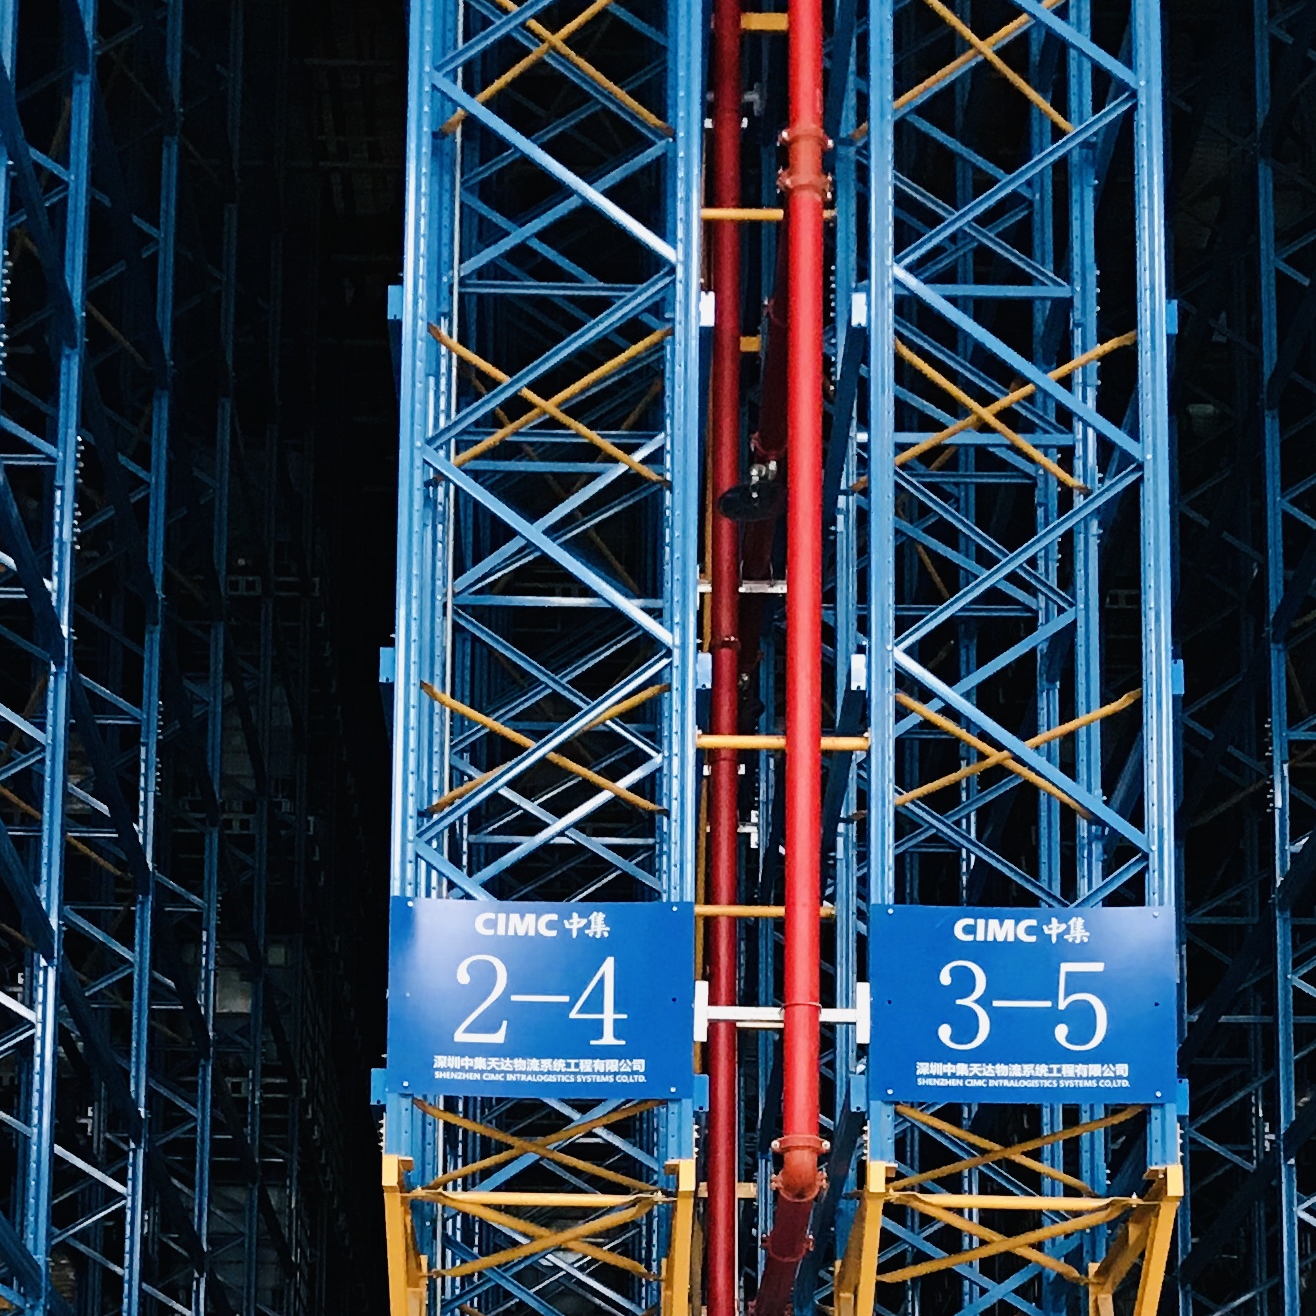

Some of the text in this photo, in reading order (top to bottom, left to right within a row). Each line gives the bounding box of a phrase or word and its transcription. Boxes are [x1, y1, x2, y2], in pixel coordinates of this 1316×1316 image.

[475, 911, 610, 938] CIMC 中集
[954, 917, 1090, 944] CIMC 中集
[483, 1072, 504, 1081] CIMC
[577, 1074, 614, 1083] SYSTEMS
[965, 1079, 987, 1087] CIMC
[1059, 1079, 1097, 1088] SYSTEMS
